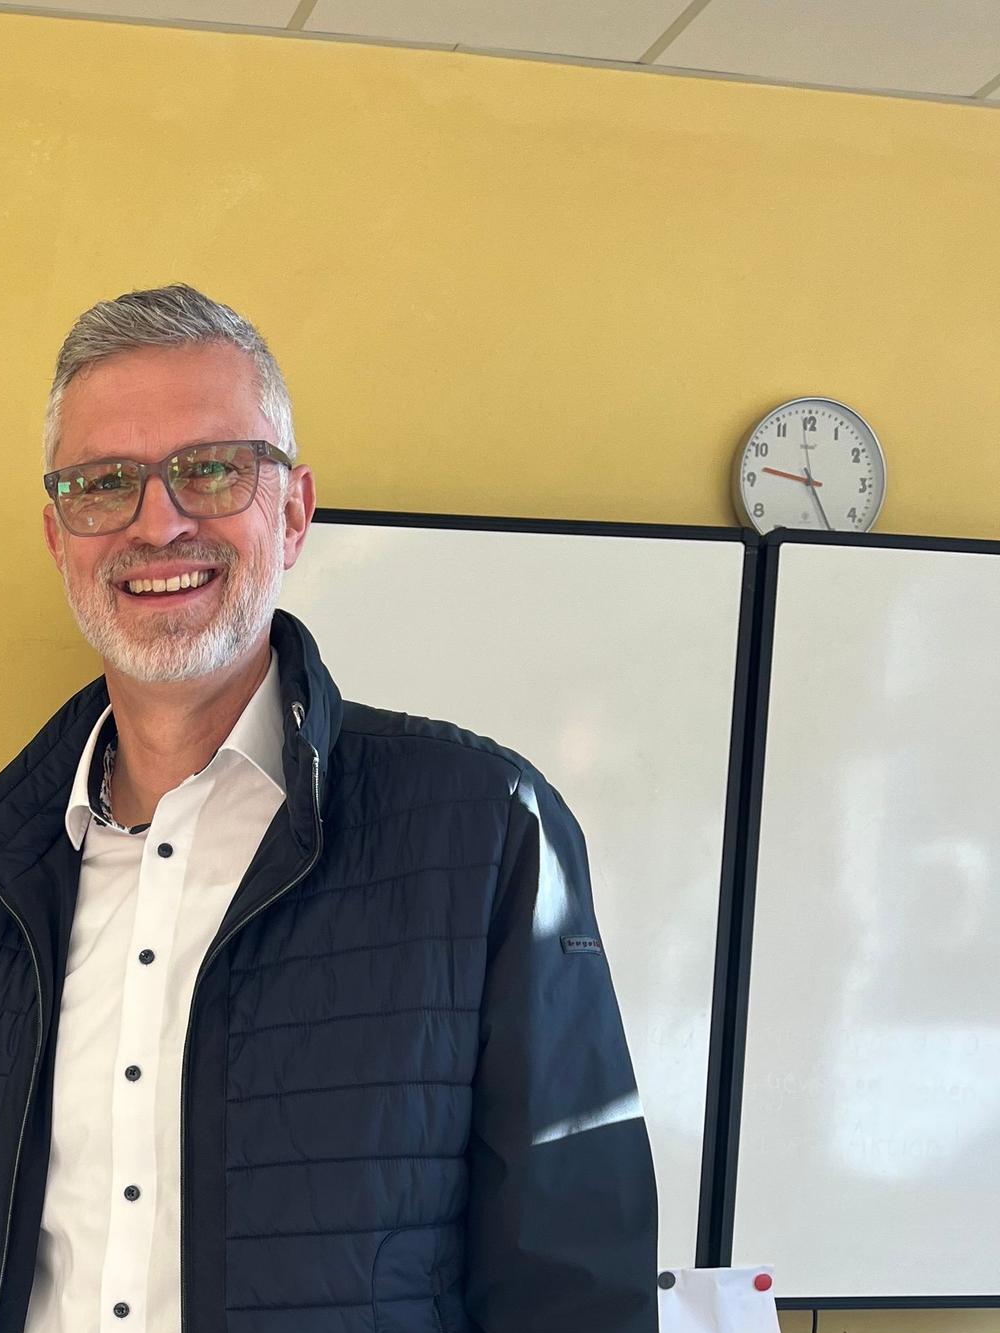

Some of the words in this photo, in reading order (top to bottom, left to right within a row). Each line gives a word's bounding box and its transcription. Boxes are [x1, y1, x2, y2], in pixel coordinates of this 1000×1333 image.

[776, 422, 787, 438] 11
[802, 415, 817, 432] 12
[833, 426, 840, 441] 1
[754, 442, 769, 458] 10
[851, 447, 861, 464] 2
[746, 471, 757, 488] 9
[858, 477, 868, 494] 3
[752, 502, 765, 518] 8
[846, 507, 858, 524] 4
